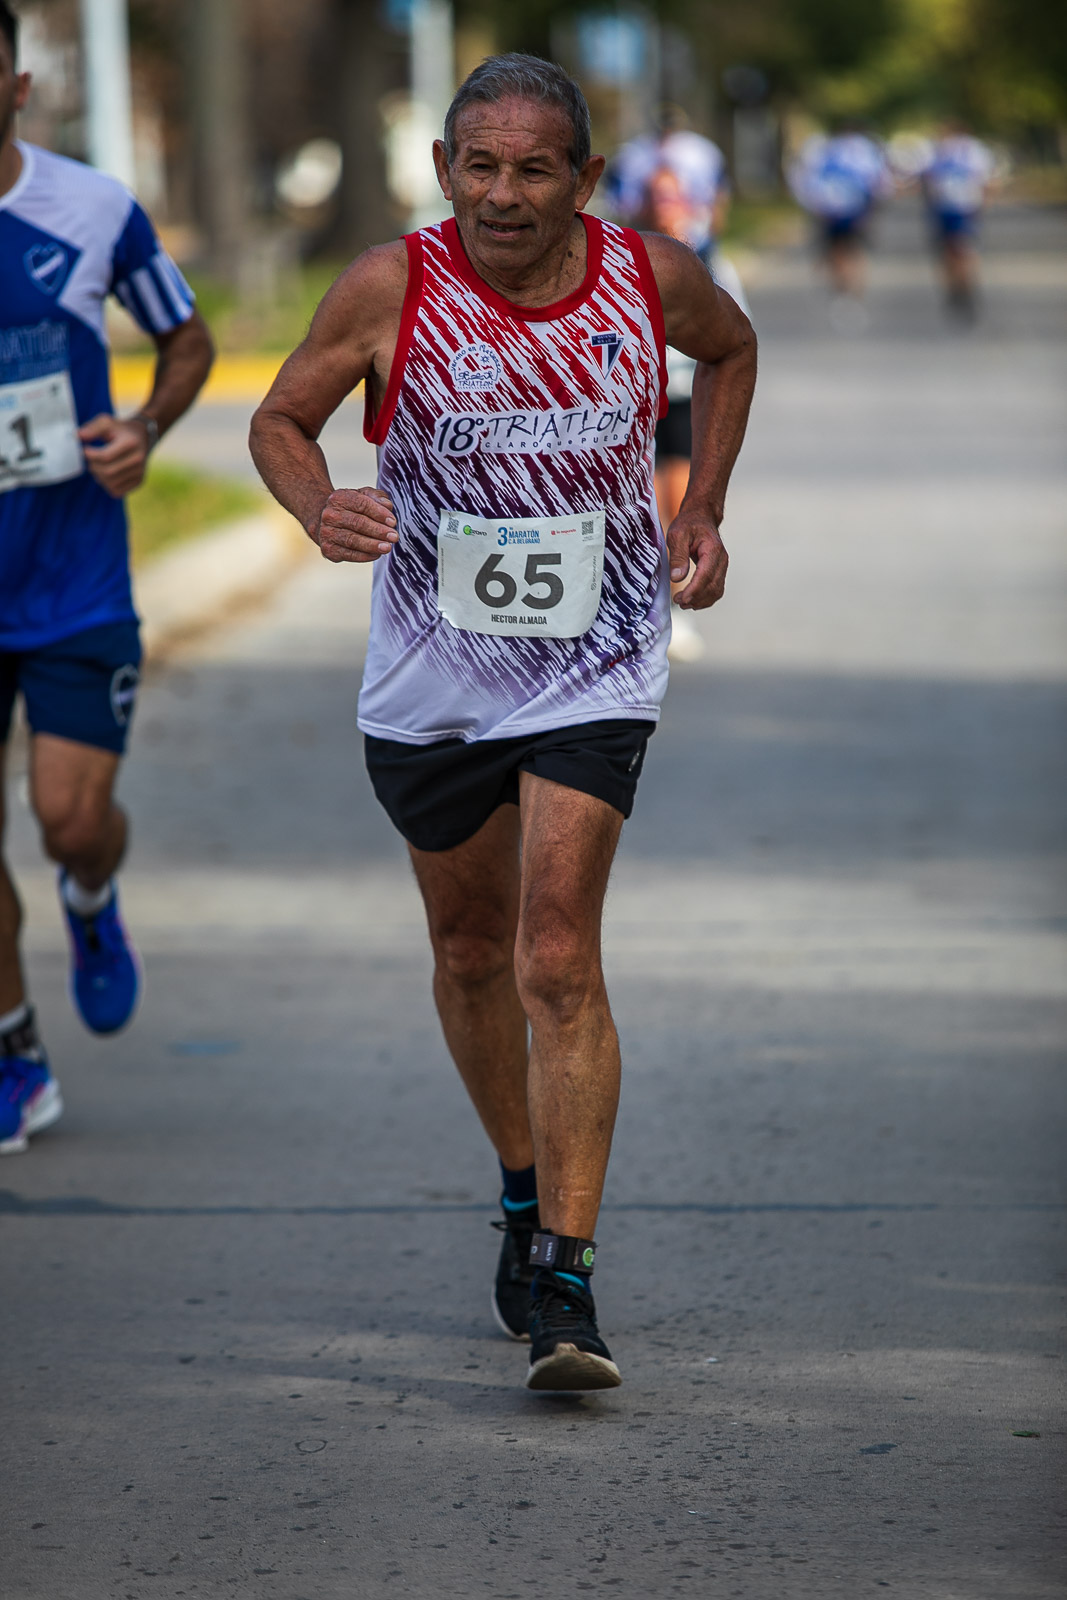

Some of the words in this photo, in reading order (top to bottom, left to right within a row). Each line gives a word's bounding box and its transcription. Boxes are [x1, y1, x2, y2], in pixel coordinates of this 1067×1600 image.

[488, 408, 631, 442] TRIATLON
[547, 439, 573, 449] que
[581, 433, 630, 444] PUEDO
[508, 529, 540, 539] MARATÓN
[474, 553, 564, 610] 65
[491, 614, 518, 625] HECTOR
[518, 614, 547, 625] ALMADA
